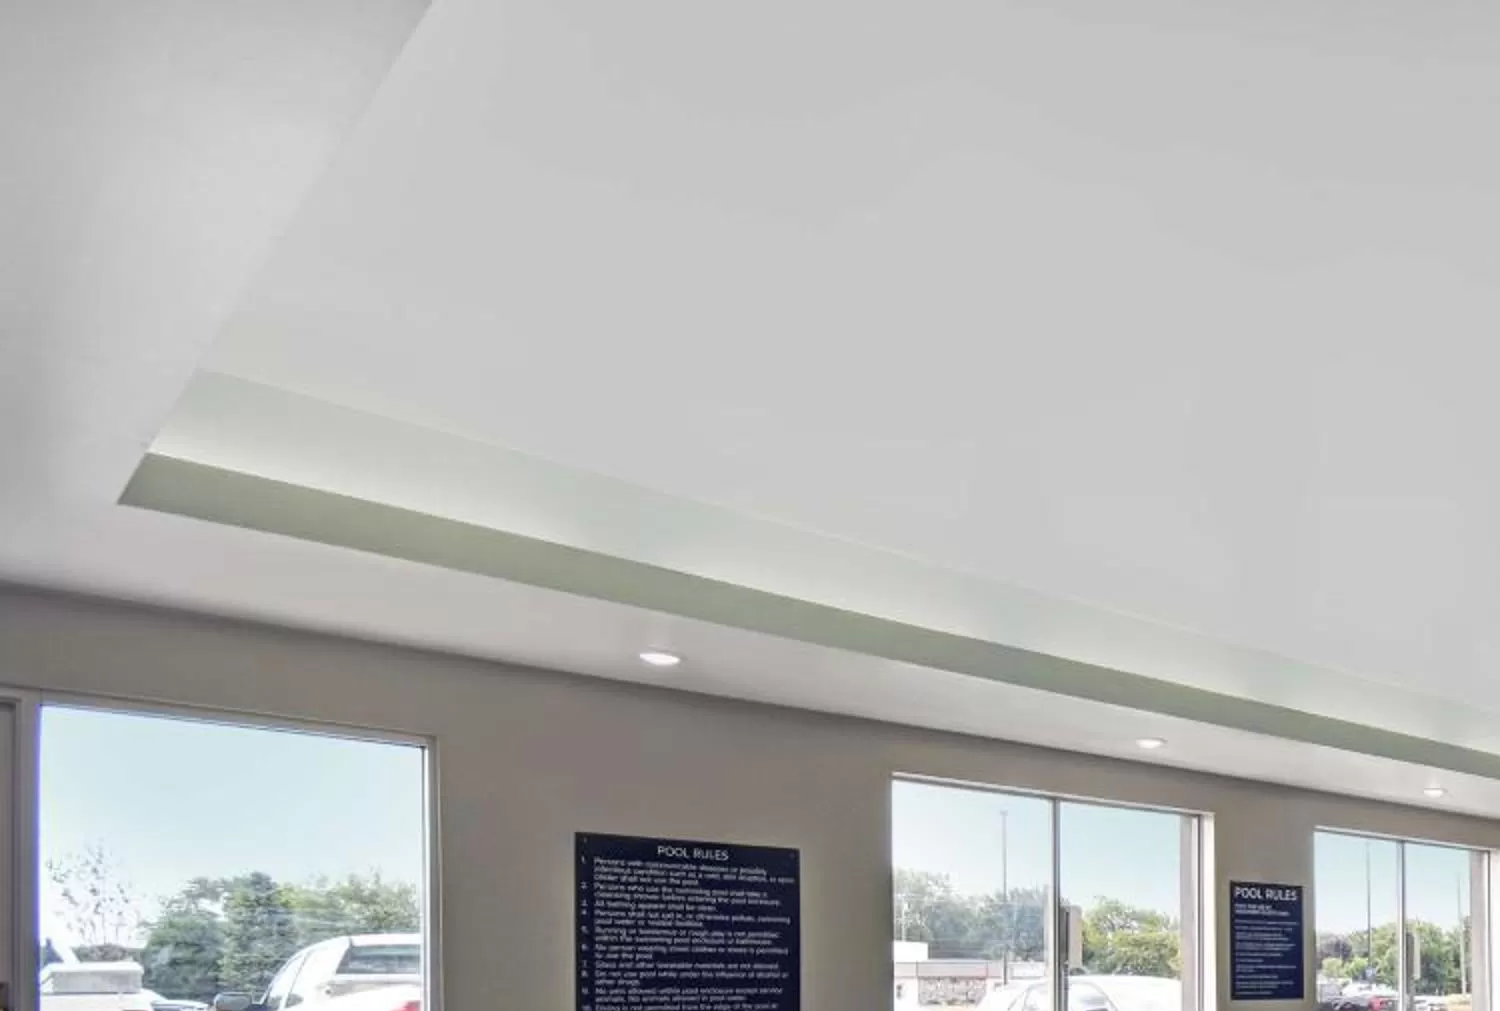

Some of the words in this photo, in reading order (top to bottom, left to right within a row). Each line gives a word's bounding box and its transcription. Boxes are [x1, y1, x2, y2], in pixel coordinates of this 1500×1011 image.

[657, 845, 690, 858] POOL
[693, 847, 729, 861] RULES
[1234, 886, 1263, 900] POOL
[1265, 888, 1297, 901] RULES
